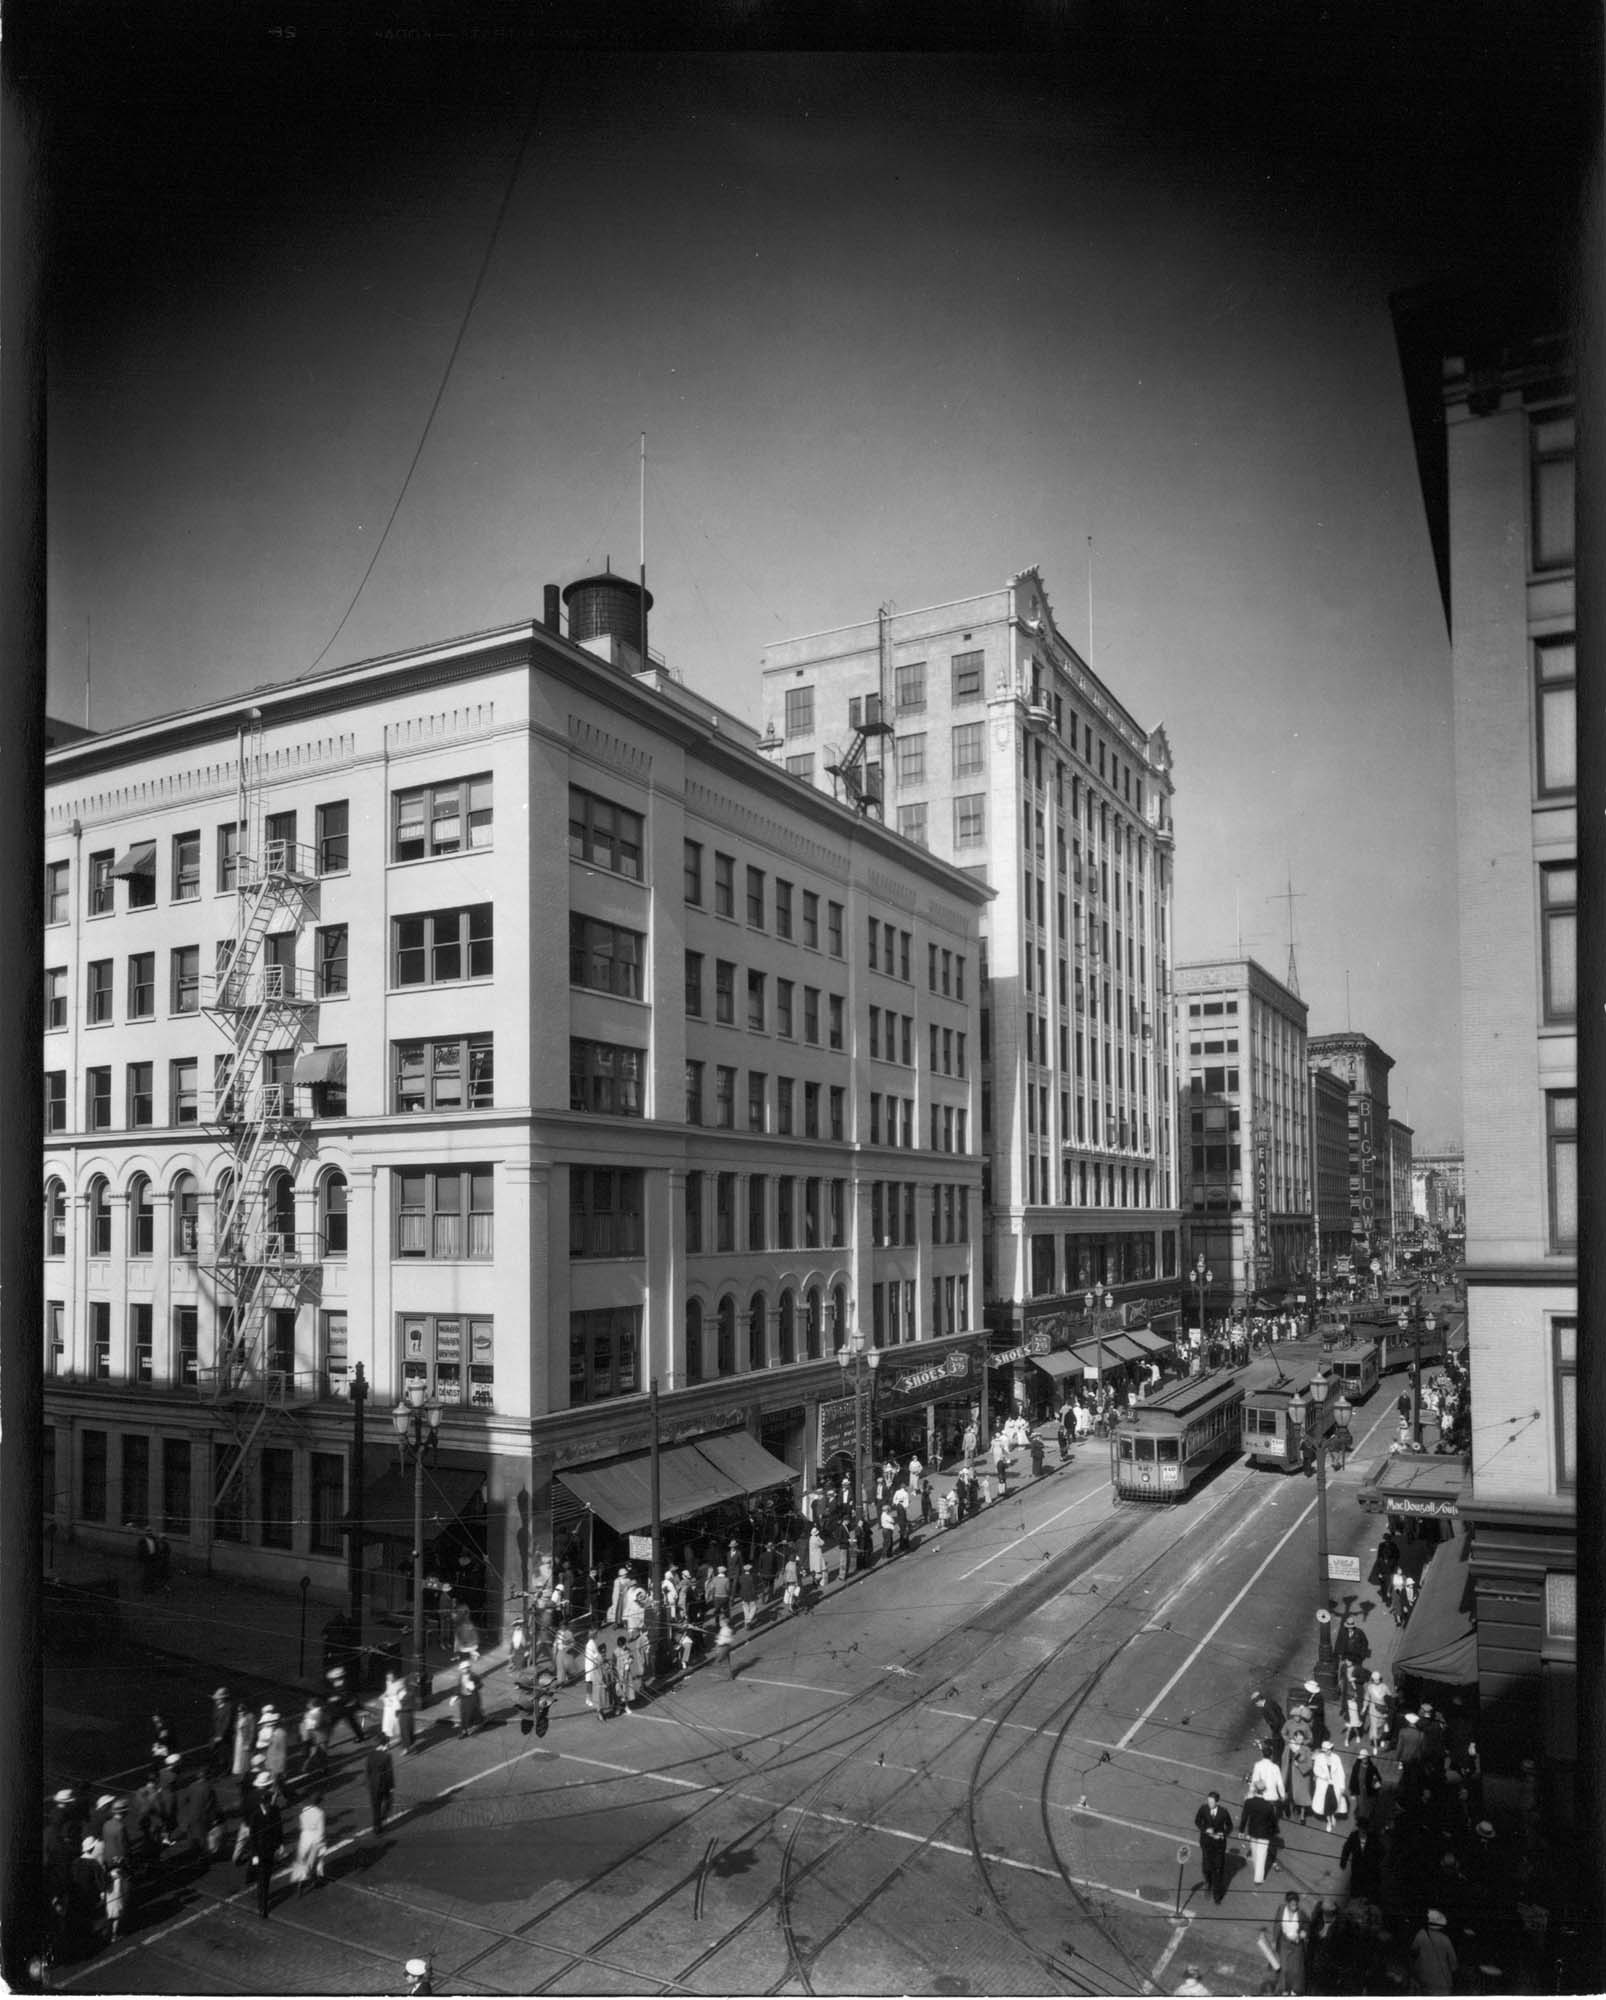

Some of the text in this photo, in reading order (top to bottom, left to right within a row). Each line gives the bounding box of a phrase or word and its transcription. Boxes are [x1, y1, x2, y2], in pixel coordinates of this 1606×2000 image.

[1360, 1102, 1374, 1230] BIGELOW
[1258, 1147, 1267, 1253] EASTERN
[904, 1367, 946, 1389] SHOES
[994, 1345, 1031, 1363] SHOES
